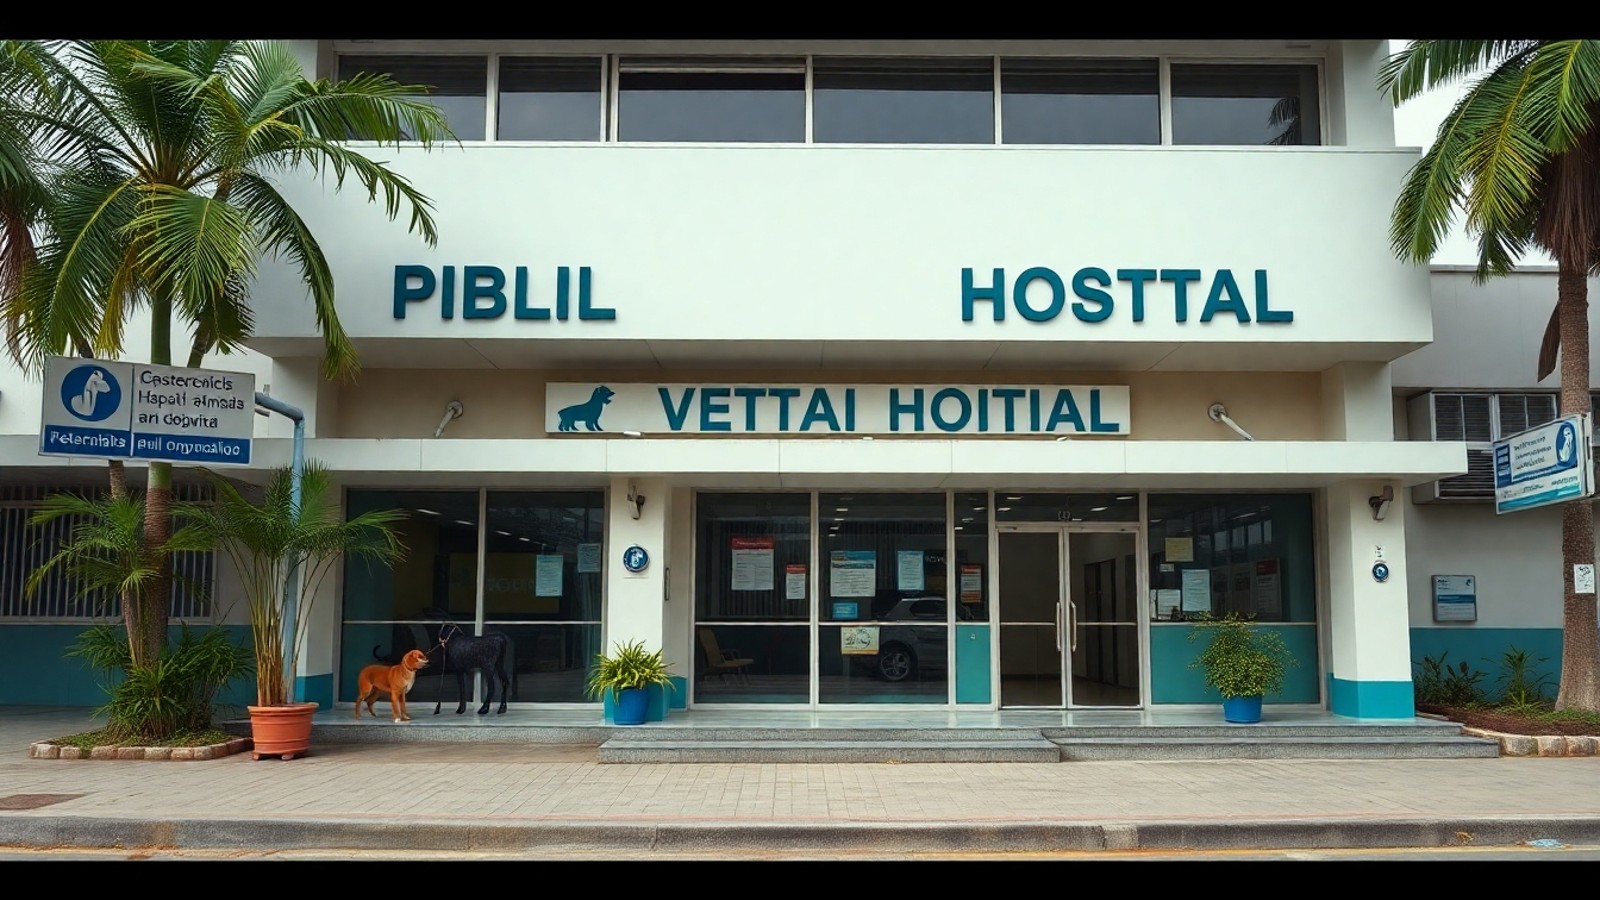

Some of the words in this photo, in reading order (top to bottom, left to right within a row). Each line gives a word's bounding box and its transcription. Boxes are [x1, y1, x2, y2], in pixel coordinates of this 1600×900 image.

[393, 265, 616, 320] PIBLIL
[961, 266, 1294, 324] HOSTTAL
[658, 387, 856, 432] VETTAI
[889, 388, 1120, 433] HOITIAL
